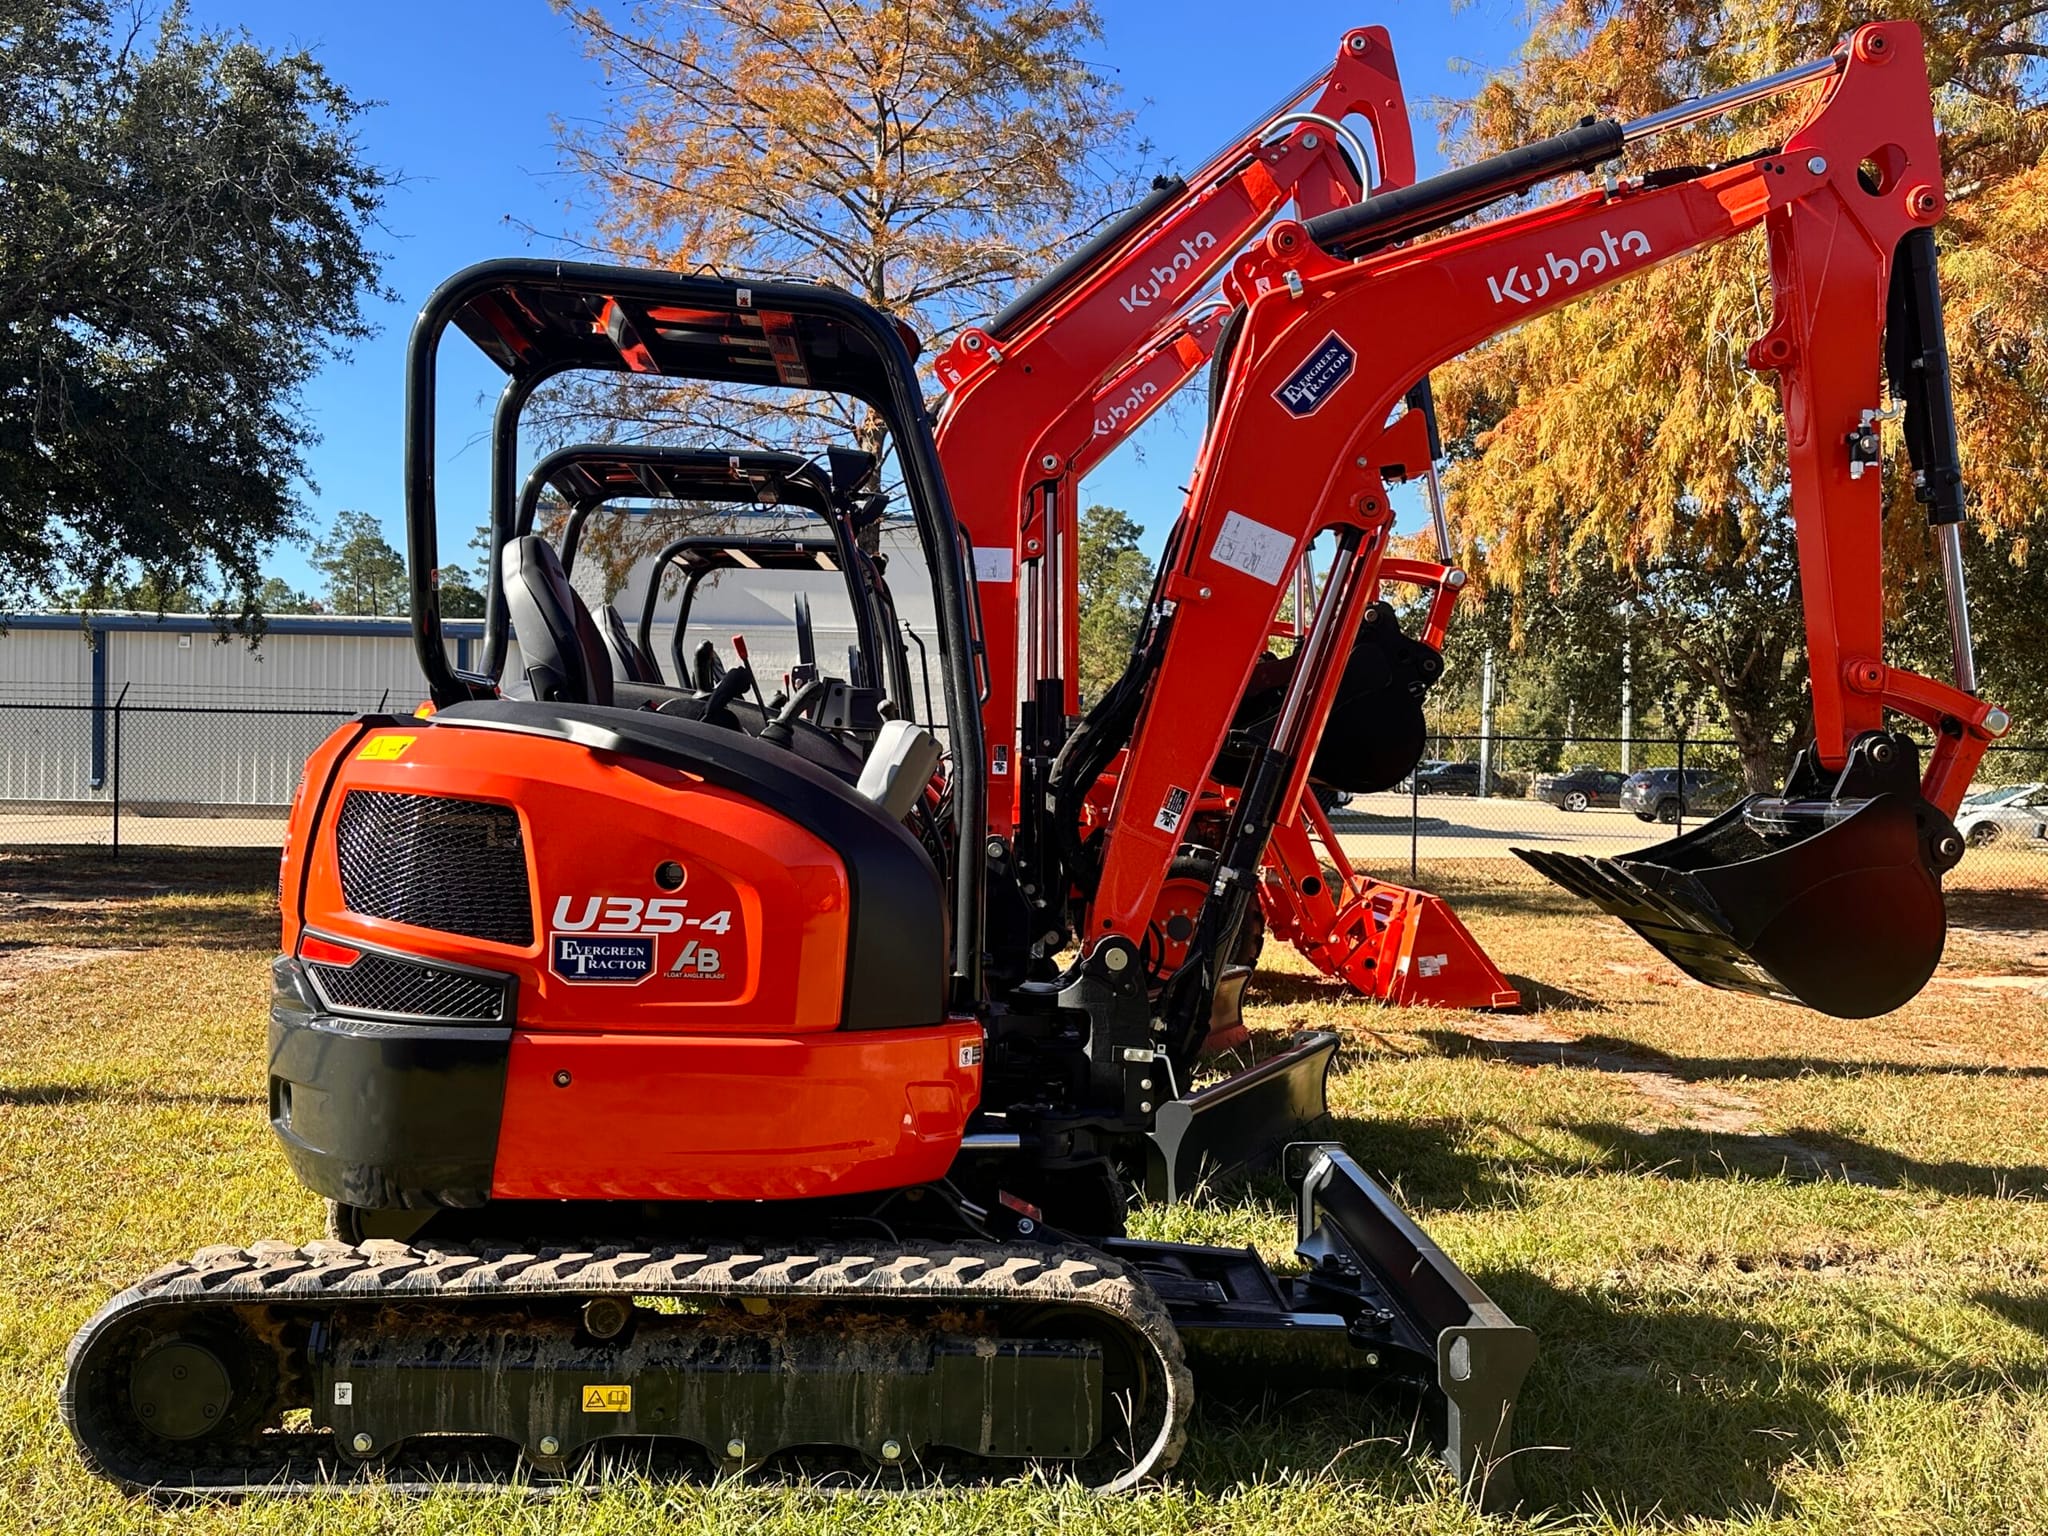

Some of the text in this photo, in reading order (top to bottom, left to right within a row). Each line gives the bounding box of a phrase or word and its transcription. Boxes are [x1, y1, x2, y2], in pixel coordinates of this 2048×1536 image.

[1119, 231, 1217, 313] Kubota
[1486, 229, 1653, 304] Kubota
[1282, 346, 1339, 405] EVERGREEN
[1300, 353, 1349, 404] TRACTOR
[1094, 382, 1158, 435] Kubota
[552, 895, 732, 935] U35-4
[560, 940, 645, 960] EVERGREEN
[572, 954, 647, 974] TRACTOR
